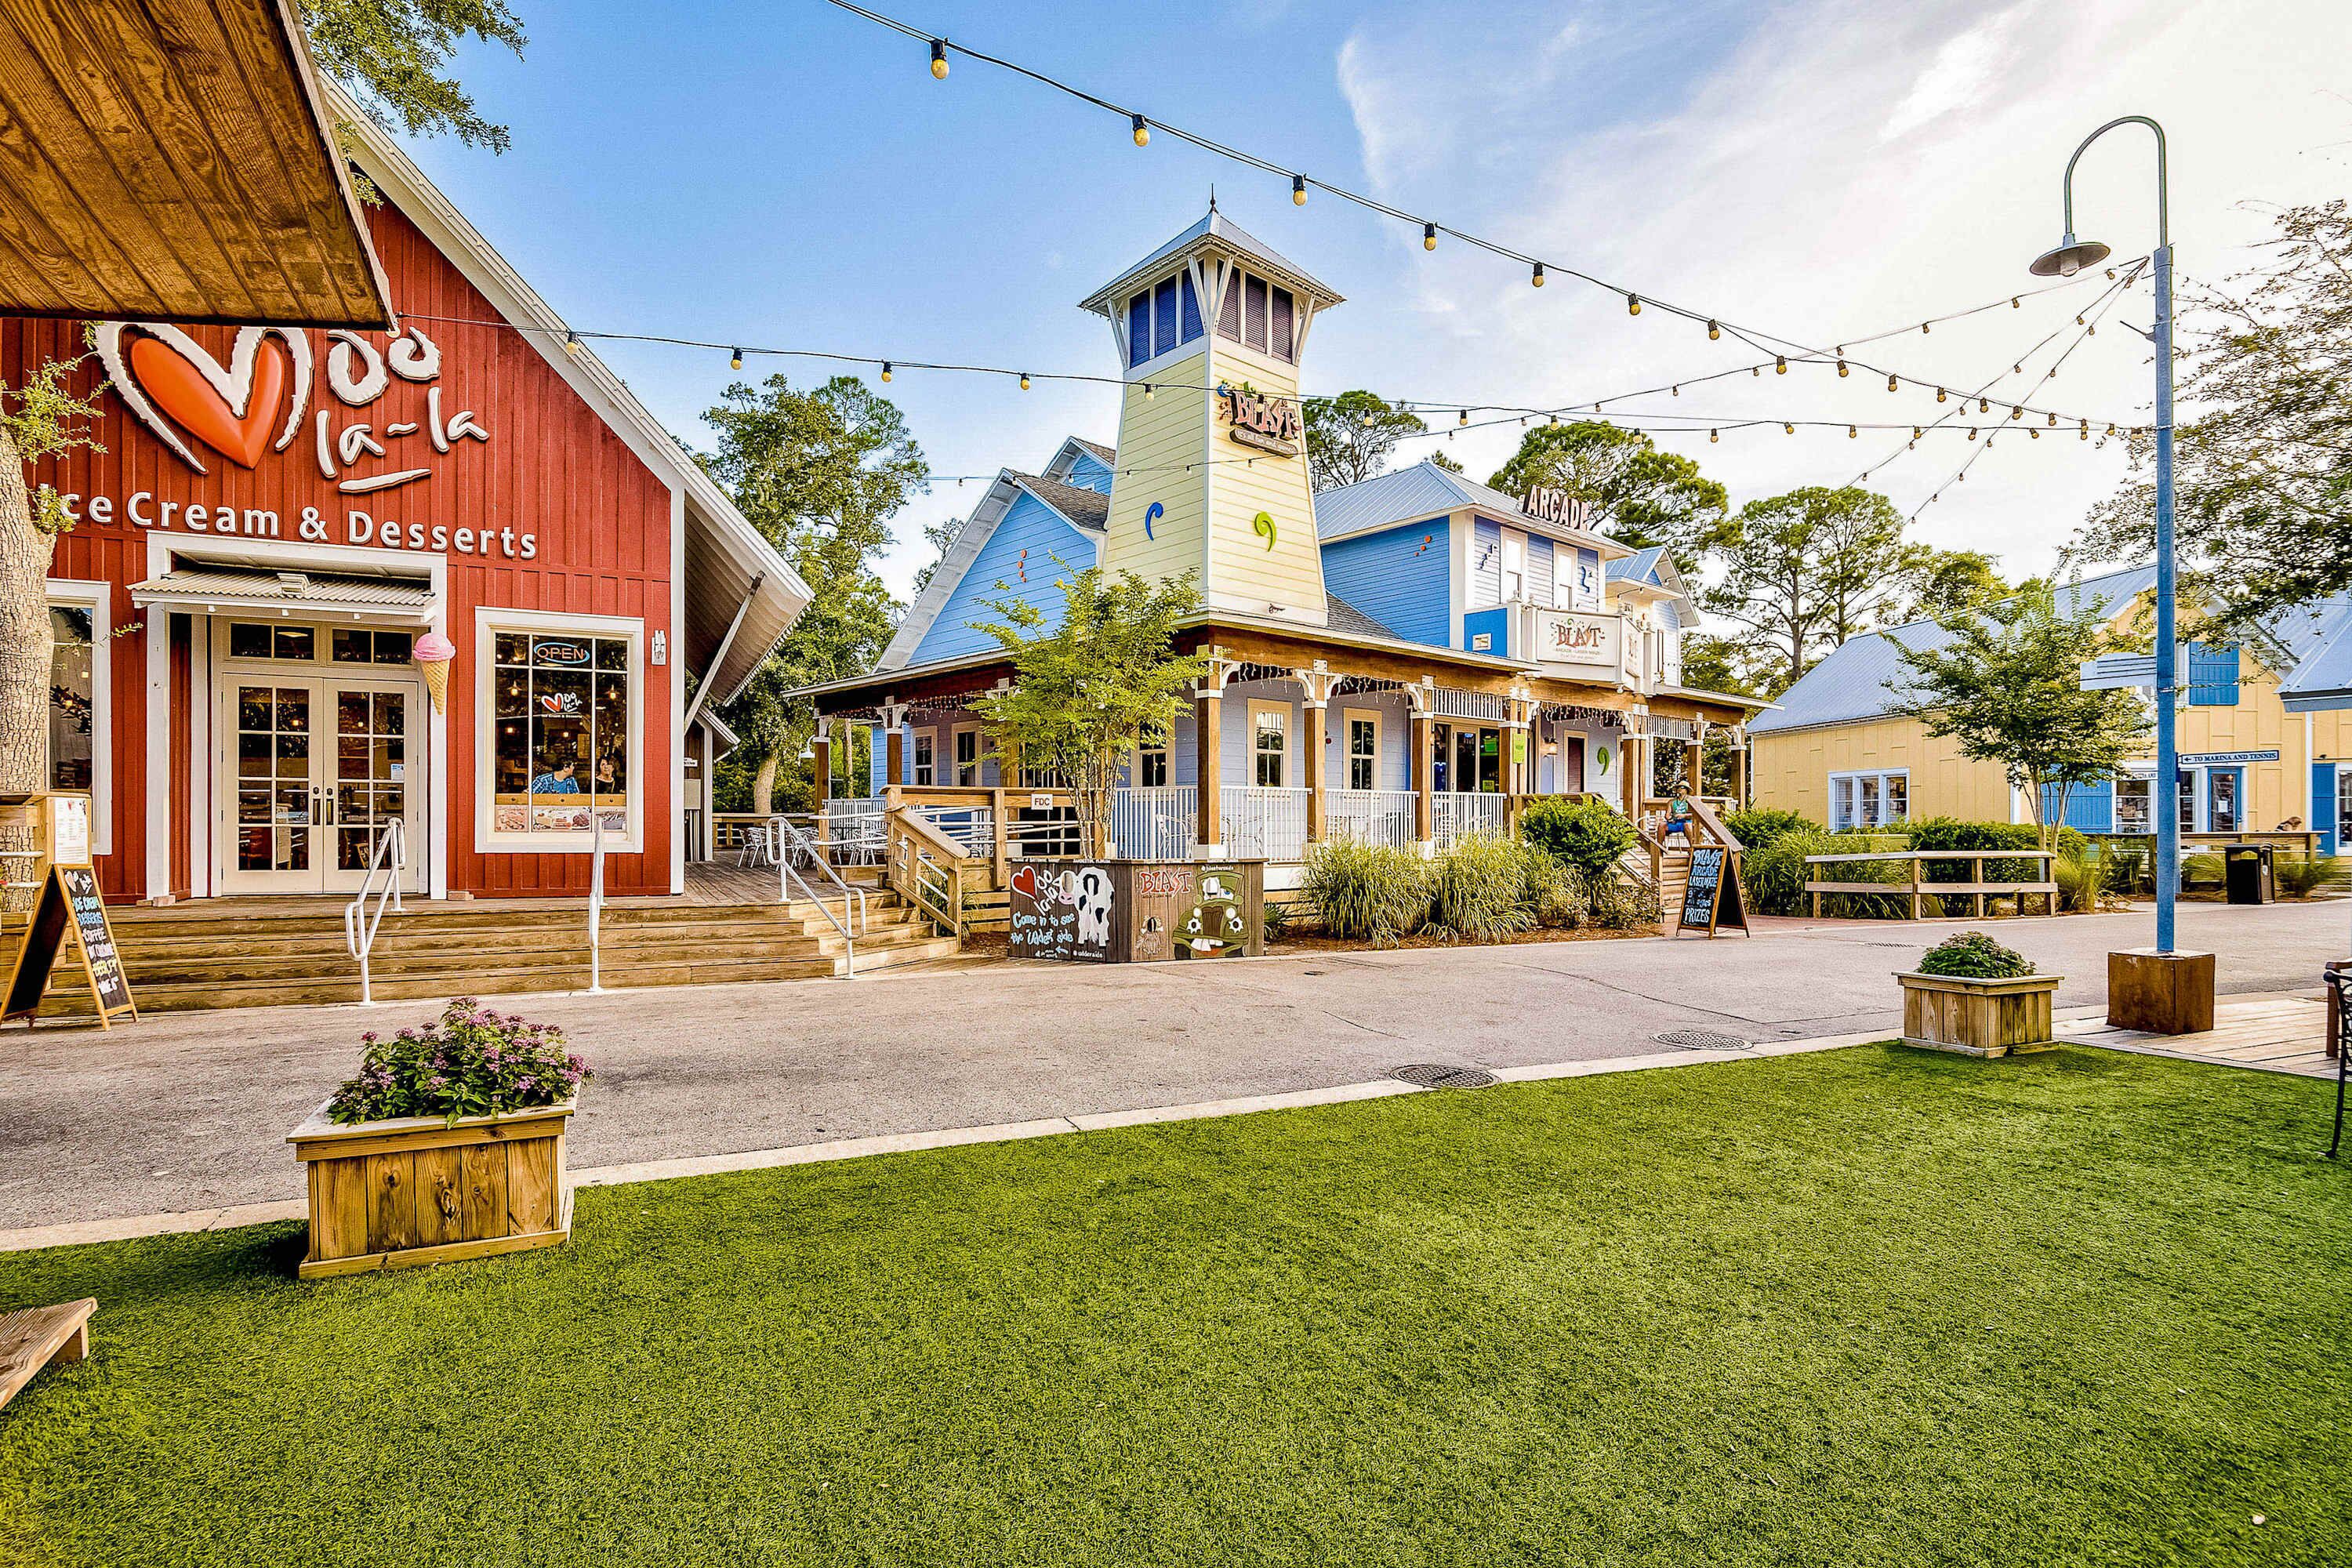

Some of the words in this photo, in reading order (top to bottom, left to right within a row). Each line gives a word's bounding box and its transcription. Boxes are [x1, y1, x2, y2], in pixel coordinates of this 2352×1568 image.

[316, 387, 490, 479] la-la
[1526, 485, 1590, 531] ARCADE
[127, 491, 279, 537] Cream
[299, 506, 329, 541] &
[347, 510, 537, 560] Desserts
[1555, 622, 1602, 648] BLAST
[537, 648, 584, 659] OPEN
[2250, 752, 2277, 760] TENNIS
[1034, 797, 1050, 806] FDC
[1693, 849, 1723, 868] BLAST
[1691, 866, 1719, 877] ARCADE
[1140, 869, 1191, 895] BLAST
[1012, 911, 1037, 929] Come
[1040, 916, 1047, 926] in
[1049, 915, 1058, 927] to
[1061, 913, 1076, 926] see
[1685, 908, 1711, 924] PRIZES
[1057, 928, 1074, 944] side
